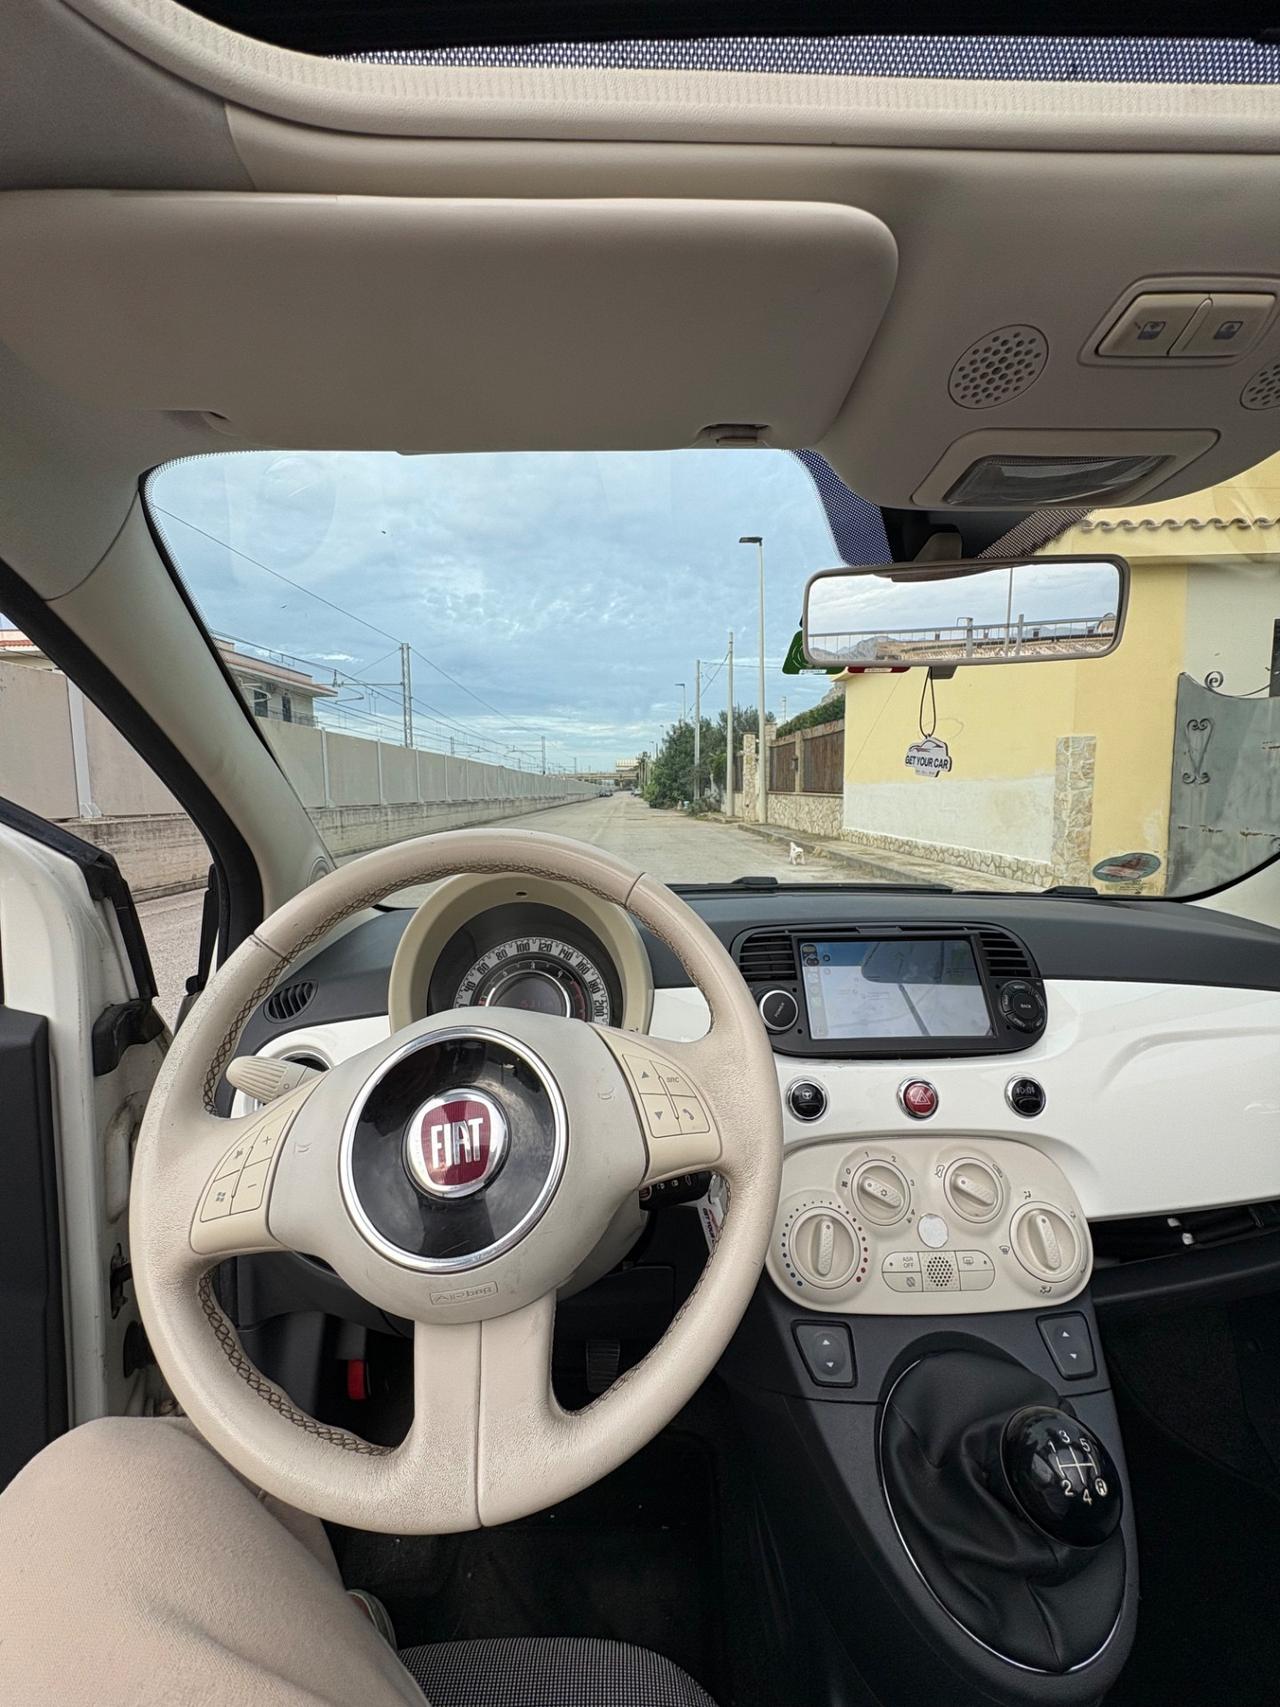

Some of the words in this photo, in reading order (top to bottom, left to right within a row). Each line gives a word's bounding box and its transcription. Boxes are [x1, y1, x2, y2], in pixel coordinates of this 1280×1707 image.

[905, 755, 915, 764] GET
[916, 757, 933, 767] YOUR
[934, 758, 948, 769] CAR
[516, 942, 530, 953] 100
[538, 942, 553, 953] 120
[558, 947, 574, 961] 140
[495, 949, 508, 961] 80
[476, 962, 490, 975] 60
[575, 960, 590, 975] 160
[463, 981, 476, 993] 40
[588, 979, 601, 994] 180
[594, 1000, 605, 1017] 200
[431, 1117, 484, 1169] FIAT
[1059, 1430, 1070, 1444] 3
[1048, 1440, 1057, 1453] 1
[1079, 1438, 1091, 1452] 5
[1061, 1479, 1074, 1496] 2
[1082, 1488, 1092, 1505] 4
